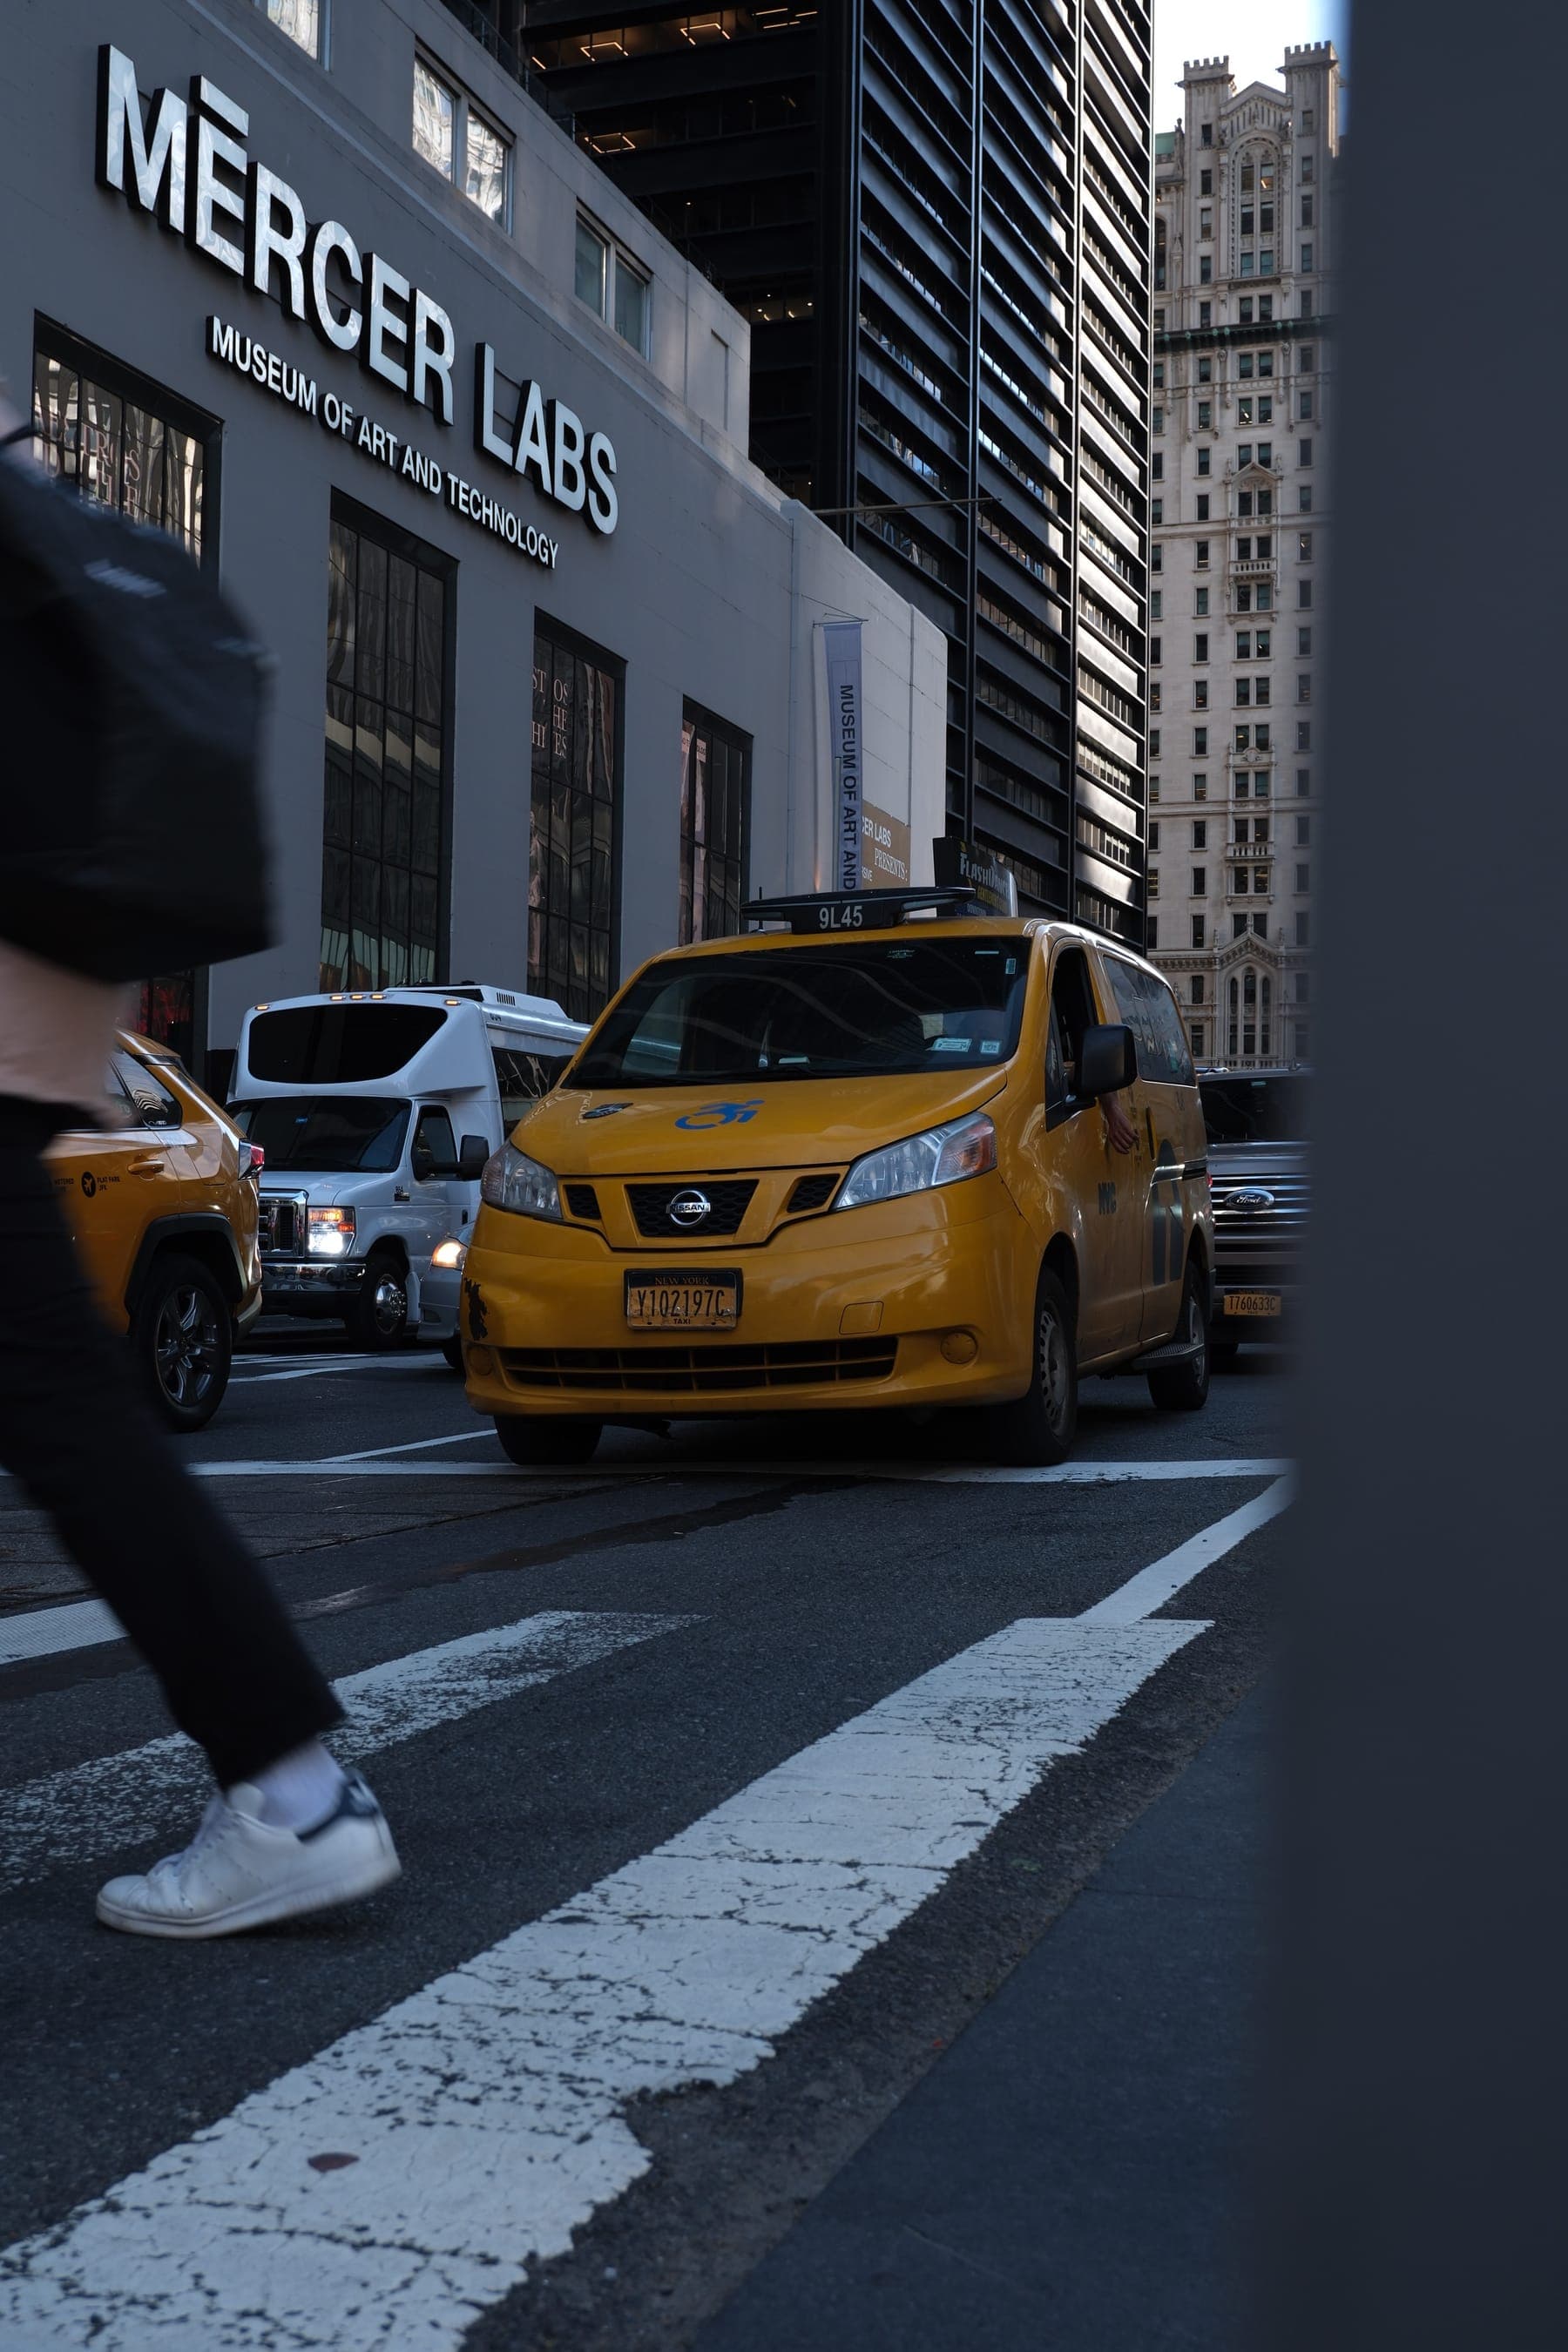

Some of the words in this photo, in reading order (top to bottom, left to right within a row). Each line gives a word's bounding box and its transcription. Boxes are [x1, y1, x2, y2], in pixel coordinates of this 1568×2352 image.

[207, 315, 317, 416] MUSEUM
[320, 393, 354, 436] OF
[355, 416, 398, 470] ART
[401, 443, 442, 496] AND
[446, 472, 559, 570] TECHNOLOGY
[476, 341, 618, 535] LABS
[840, 685, 856, 769] MUSEUM
[842, 775, 856, 802] OF
[842, 808, 856, 845] ART
[874, 823, 889, 847] LABS
[842, 850, 856, 891] AND
[819, 905, 862, 928] 9L45
[1236, 1194, 1261, 1205] Ford
[655, 1275, 679, 1285] NEW
[682, 1274, 710, 1285] YORK
[638, 1289, 725, 1317] Y102197C
[1229, 1295, 1275, 1311] T760633C
